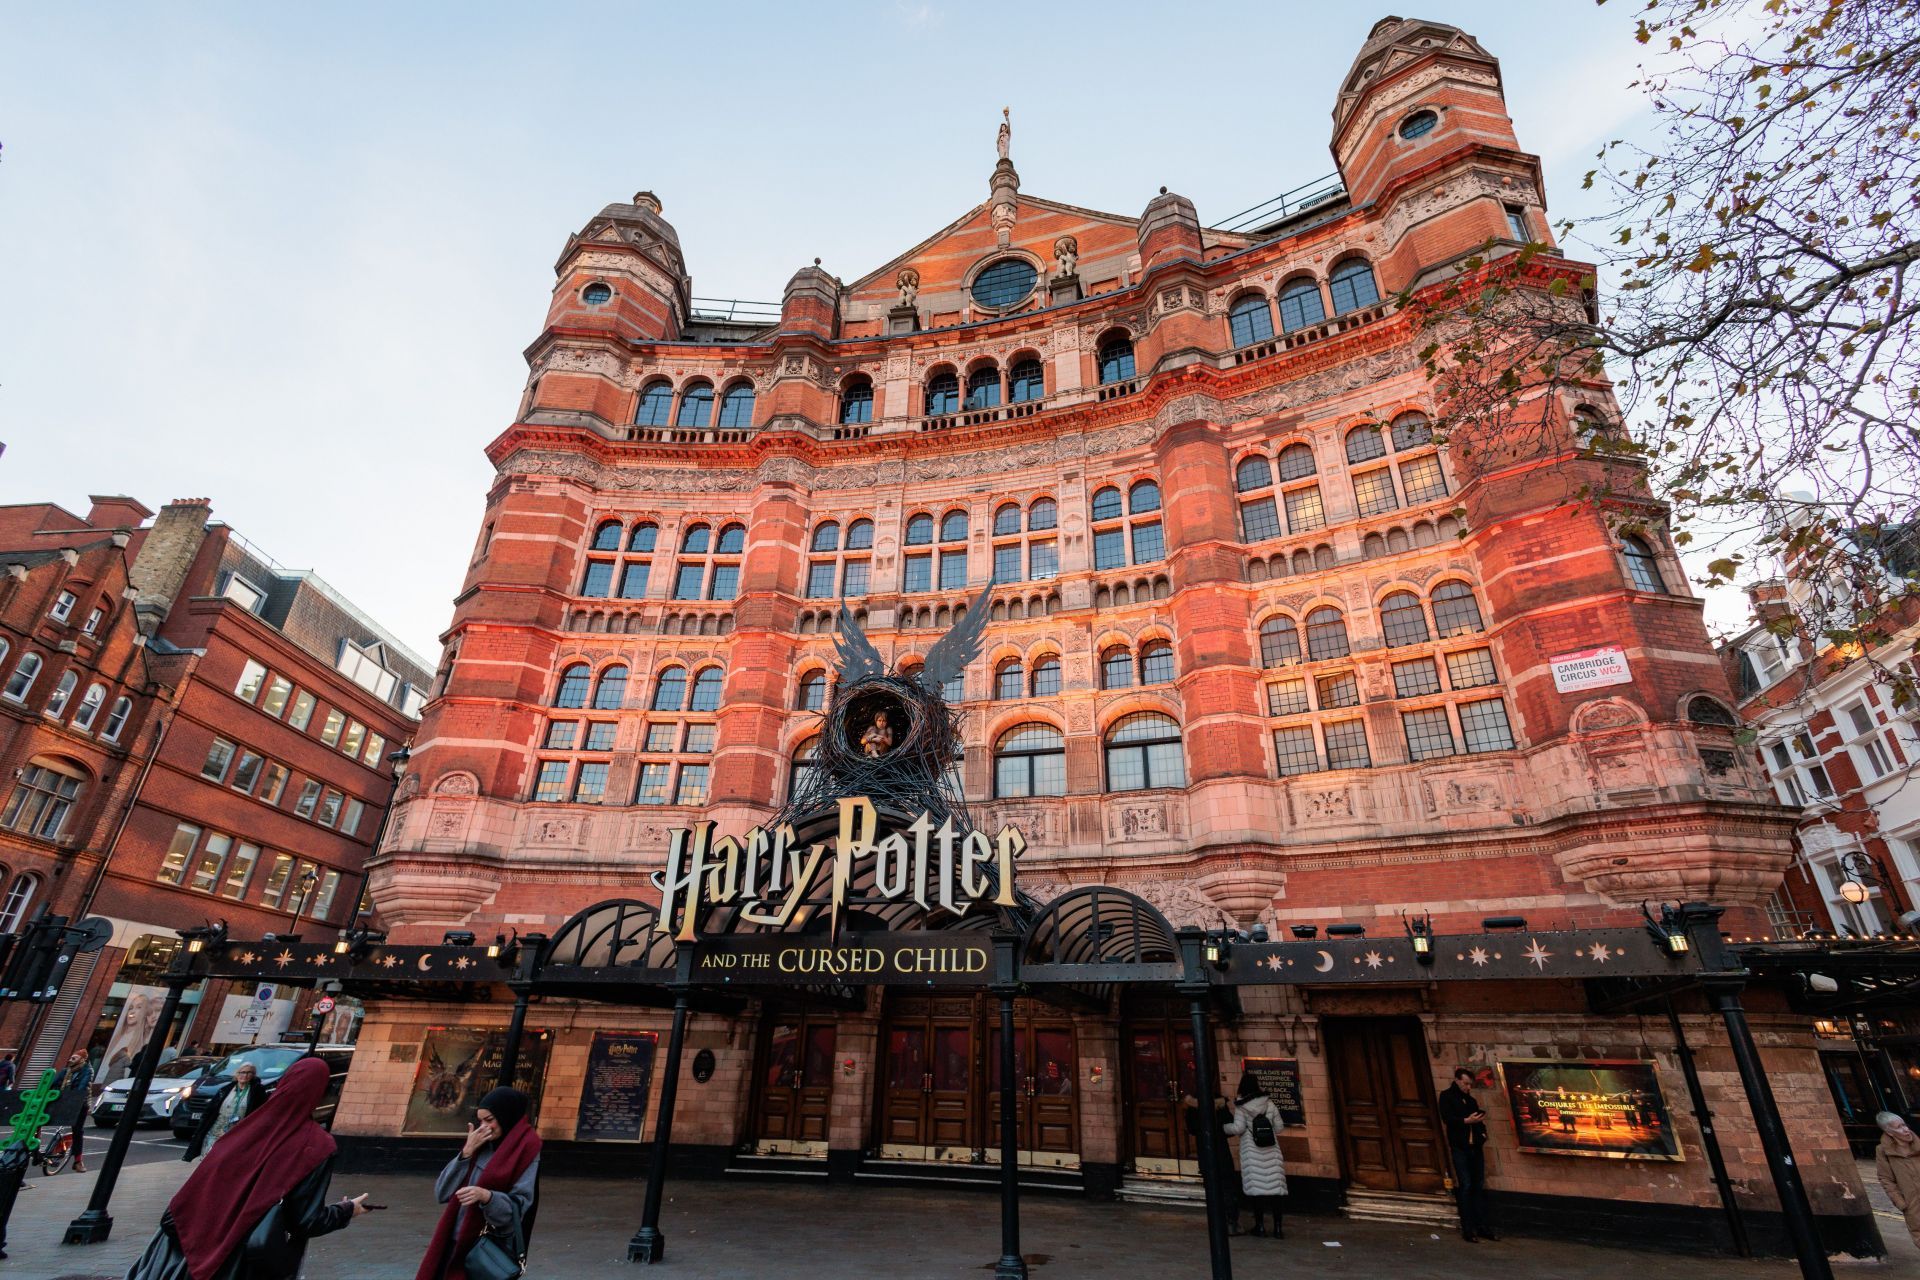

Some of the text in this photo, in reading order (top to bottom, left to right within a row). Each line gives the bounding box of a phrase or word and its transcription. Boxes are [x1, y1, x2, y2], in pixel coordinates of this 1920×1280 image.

[1557, 656, 1616, 674] CAMBRIDGE
[1560, 665, 1623, 683] CIRCUS WC2
[650, 797, 1029, 947] Harry Potter
[701, 948, 987, 975] AND THE CURSED CHILD
[320, 1001, 332, 1009] 20
[1538, 1100, 1577, 1109] CONJURES
[1594, 1102, 1636, 1111] IMPOSSIBLE
